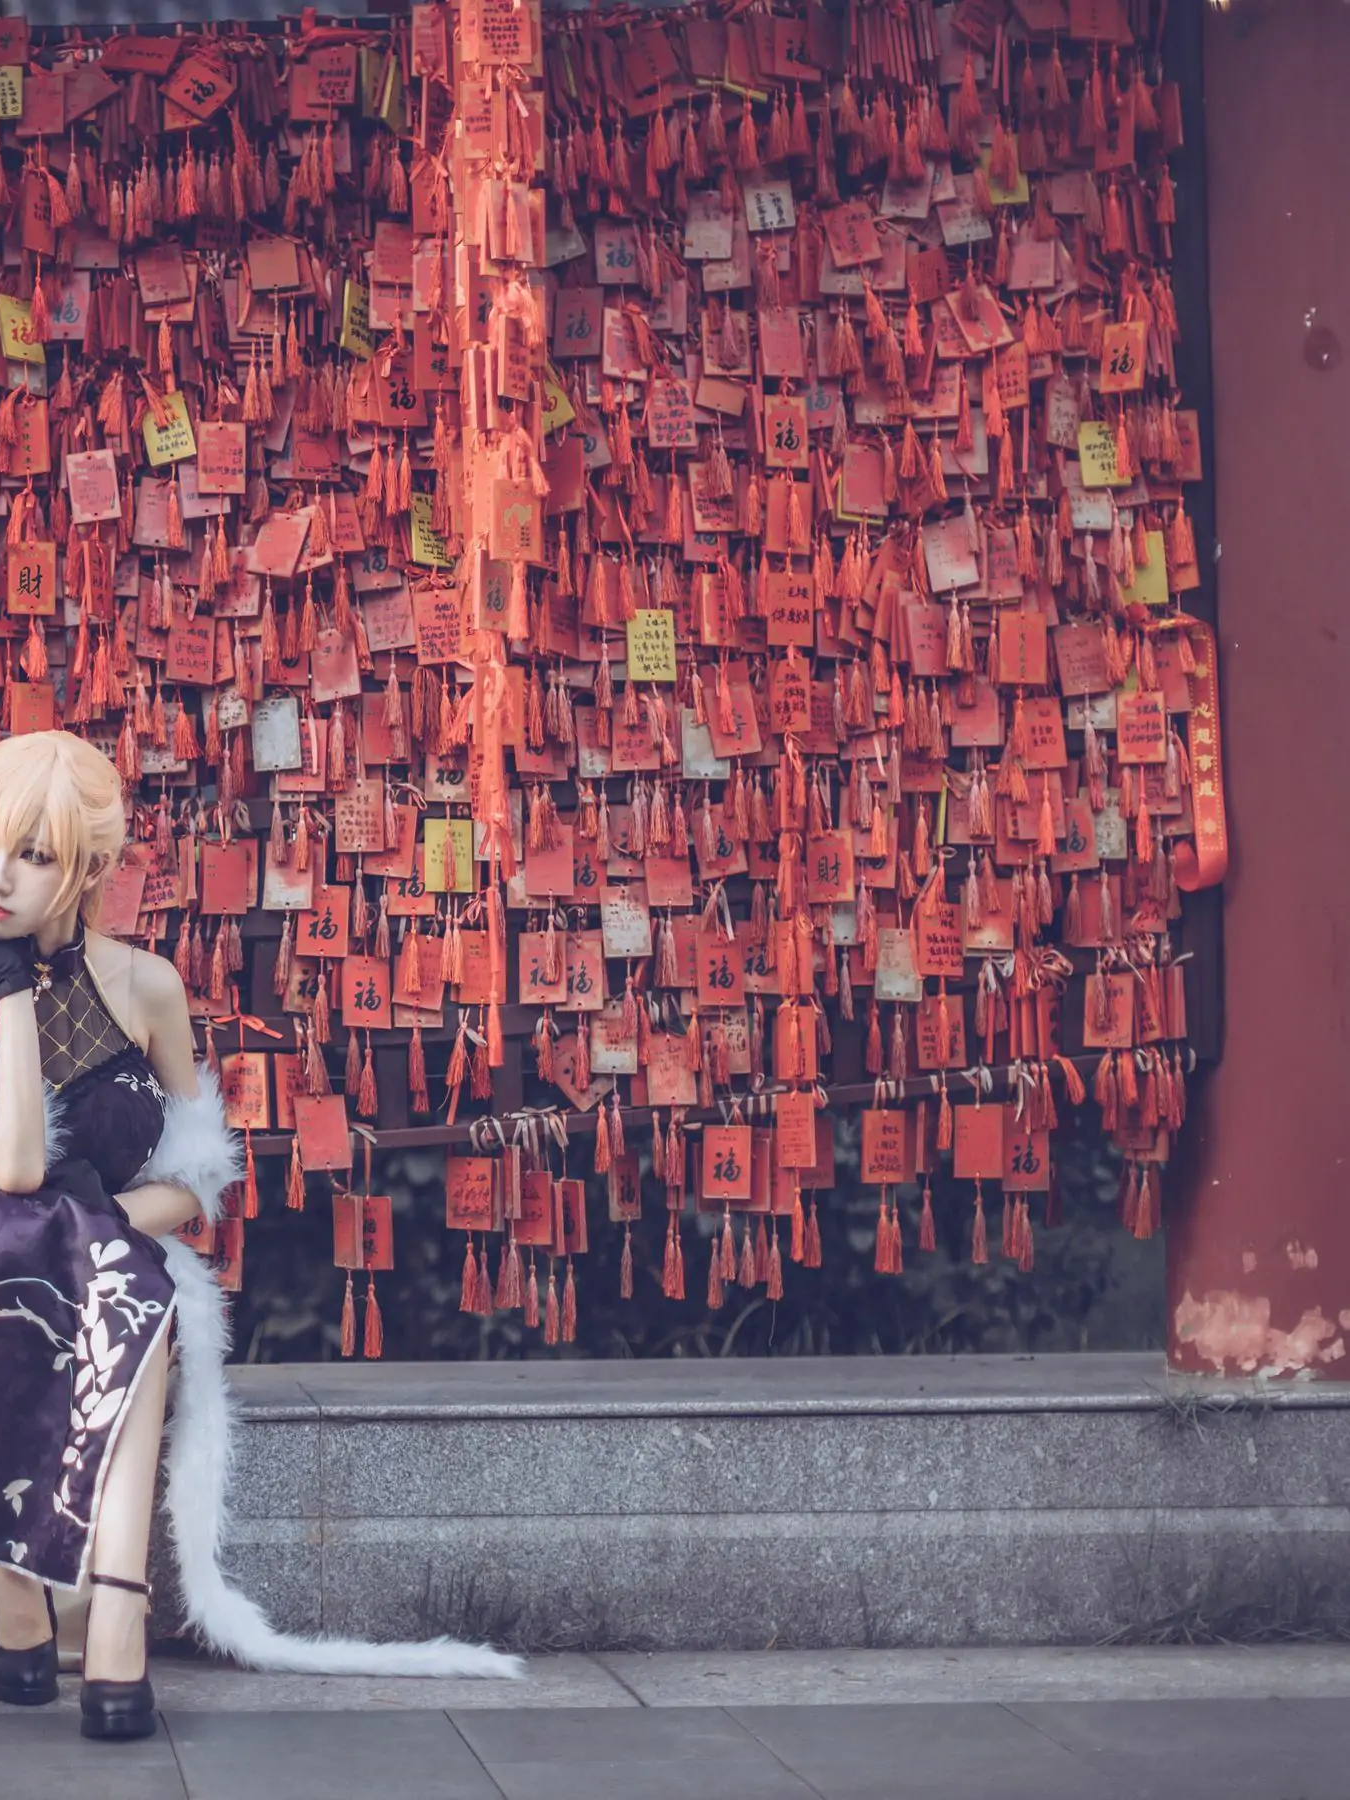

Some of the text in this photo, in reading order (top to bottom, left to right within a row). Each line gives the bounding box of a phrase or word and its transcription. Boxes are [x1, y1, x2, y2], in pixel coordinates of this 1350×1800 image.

[785, 36, 806, 64] 福
[184, 78, 216, 105] 福
[605, 237, 632, 267] 福
[54, 295, 79, 324] 福
[566, 308, 591, 339] 福
[10, 316, 34, 345] 福
[1108, 343, 1133, 374] 福
[389, 377, 416, 410] 福
[774, 417, 799, 449] 福
[16, 564, 43, 600] 財
[486, 578, 505, 611] 福
[1193, 702, 1215, 796] 心想事成
[1057, 820, 1085, 853] 福
[397, 864, 425, 897] 福
[572, 854, 596, 887] 福
[815, 853, 840, 886] 財
[309, 906, 337, 939] 福
[708, 955, 734, 988] 福
[744, 943, 771, 977] 福
[566, 960, 592, 994] 福
[354, 977, 381, 1011] 福
[713, 1147, 741, 1182] 福
[1011, 1139, 1039, 1174] 福
